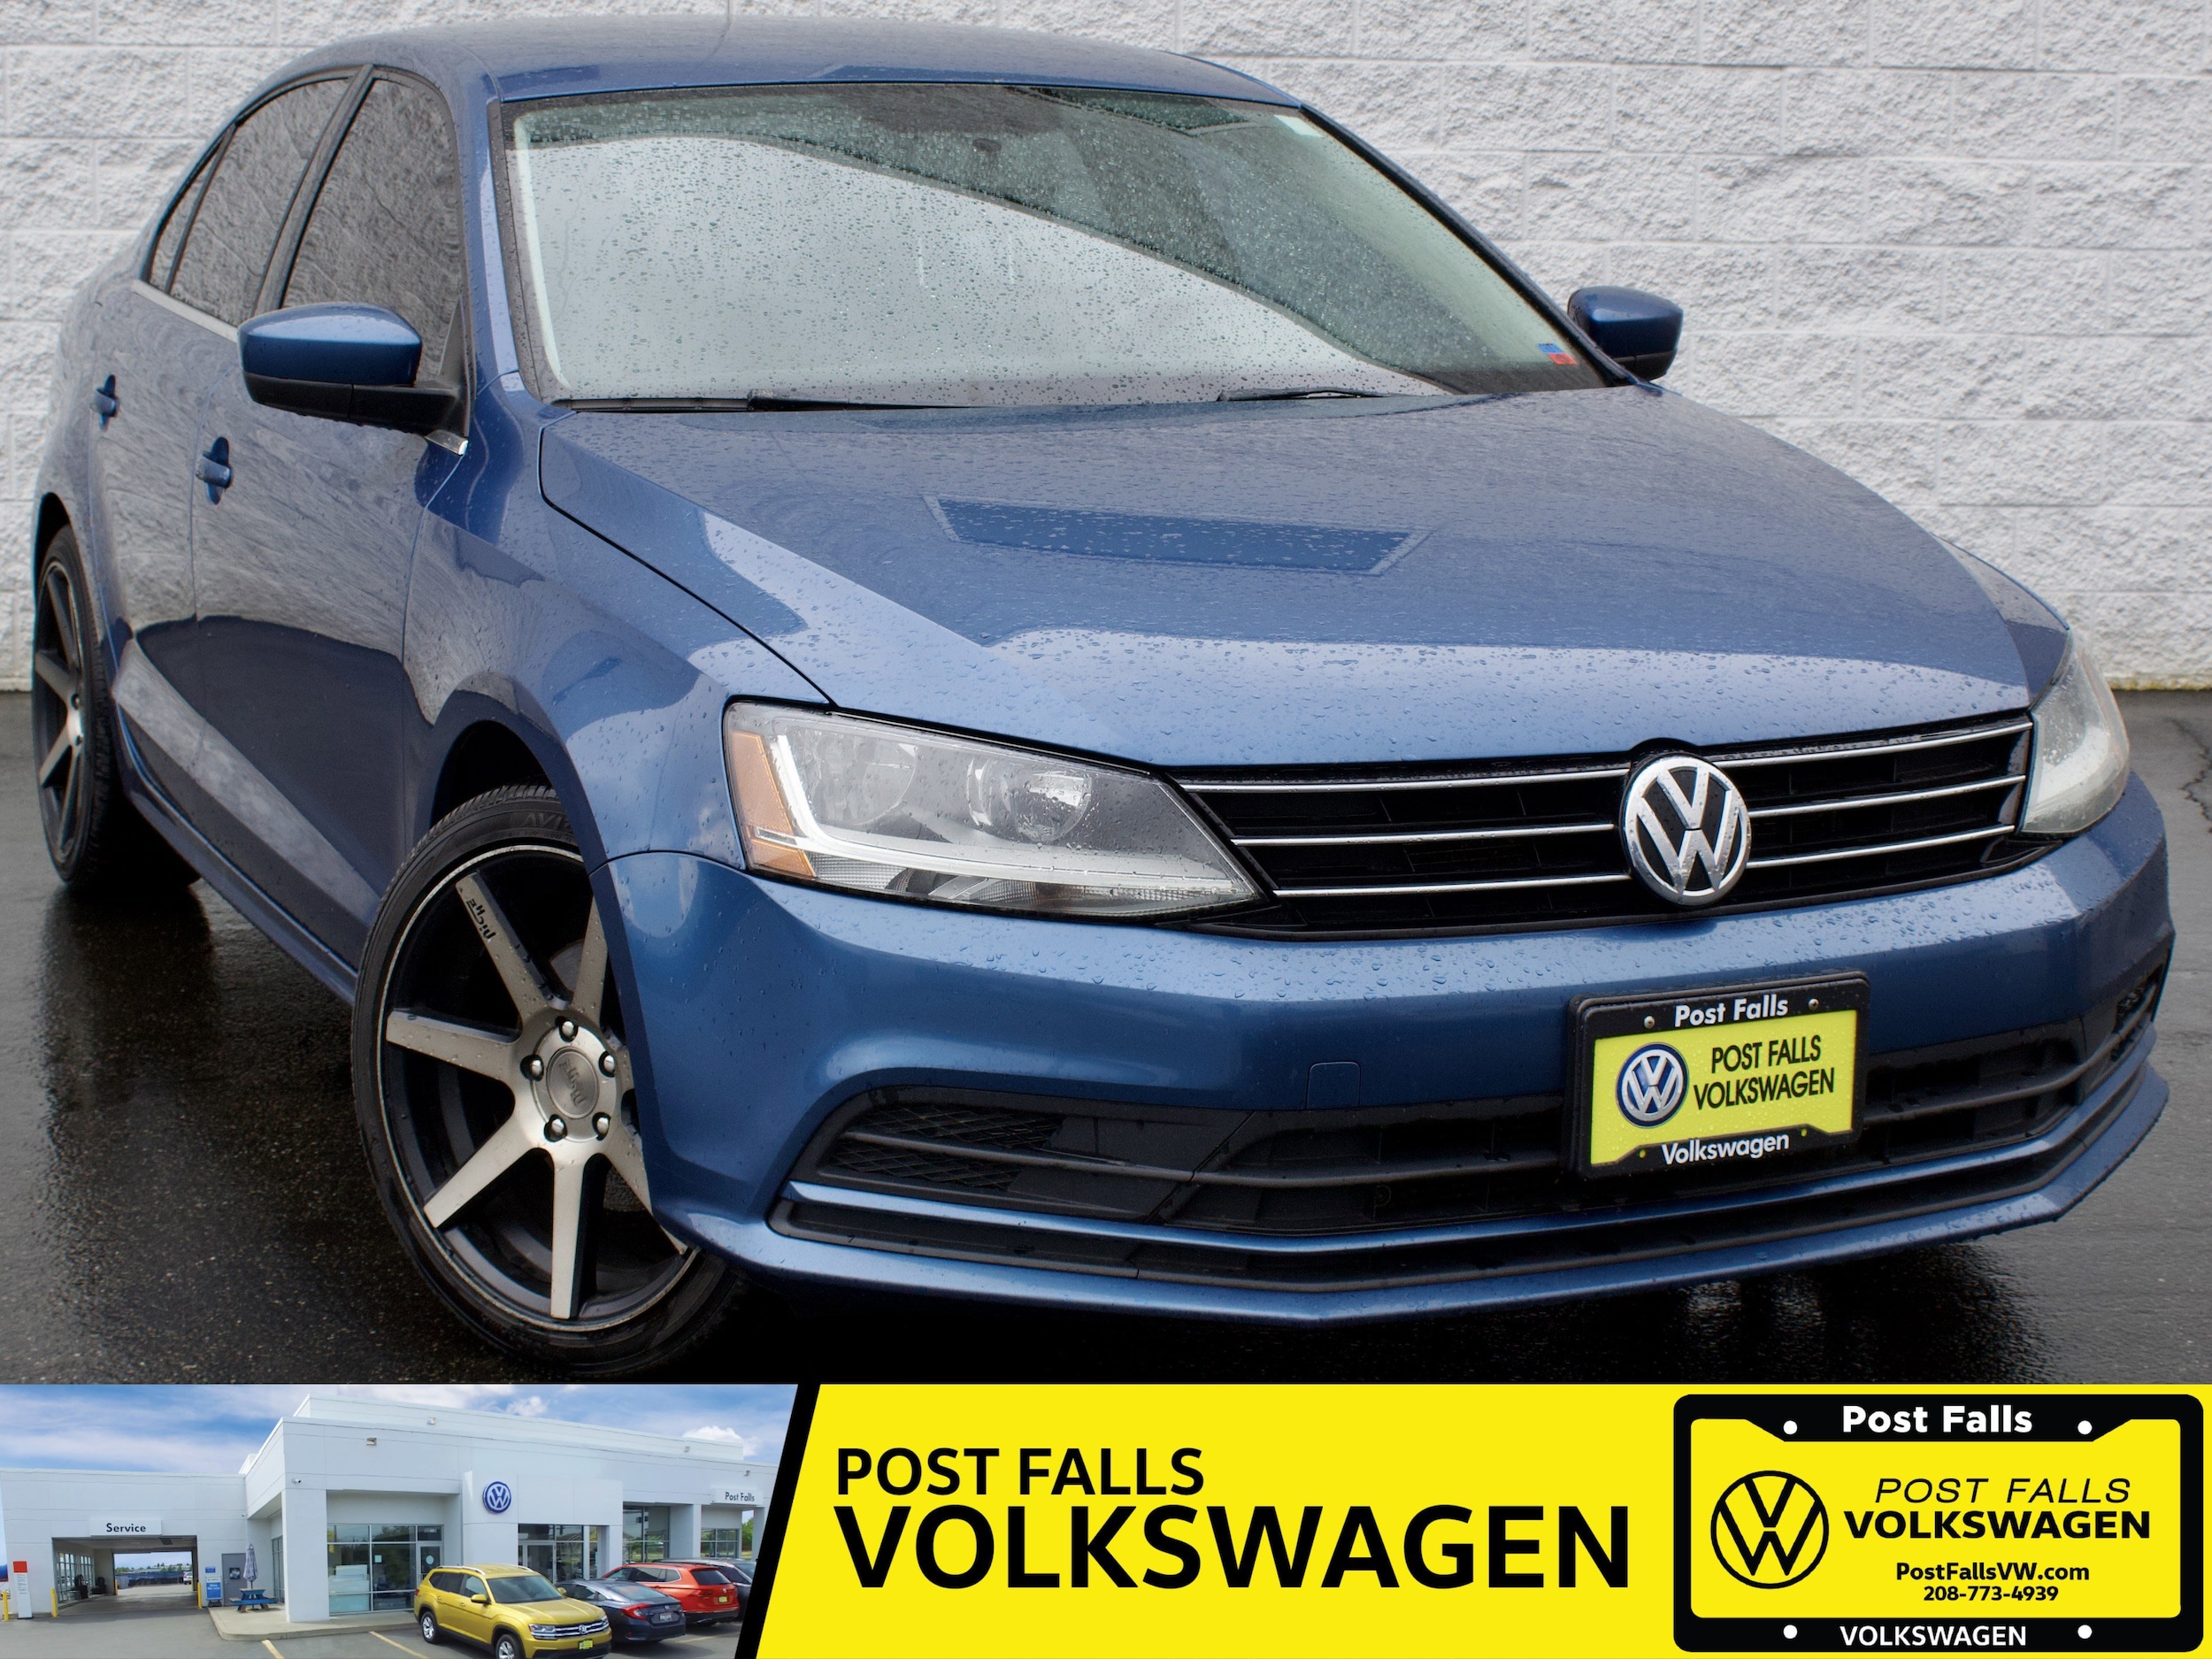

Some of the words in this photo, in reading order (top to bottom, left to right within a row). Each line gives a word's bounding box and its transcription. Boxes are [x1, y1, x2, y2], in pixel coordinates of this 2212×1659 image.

[1630, 757, 1745, 899] VW
[1674, 1002, 1726, 1028] Post
[1732, 993, 1788, 1022] Falls
[1711, 1041, 1763, 1074] POST
[1768, 1034, 1822, 1067] FALLS
[1621, 1049, 1685, 1124] VW
[1694, 1067, 1835, 1110] VOLKSWAGEN
[1661, 1133, 1790, 1166] Volkswagen
[725, 1492, 739, 1502] Post
[740, 1492, 755, 1502] Falls
[105, 1522, 147, 1532] Service
